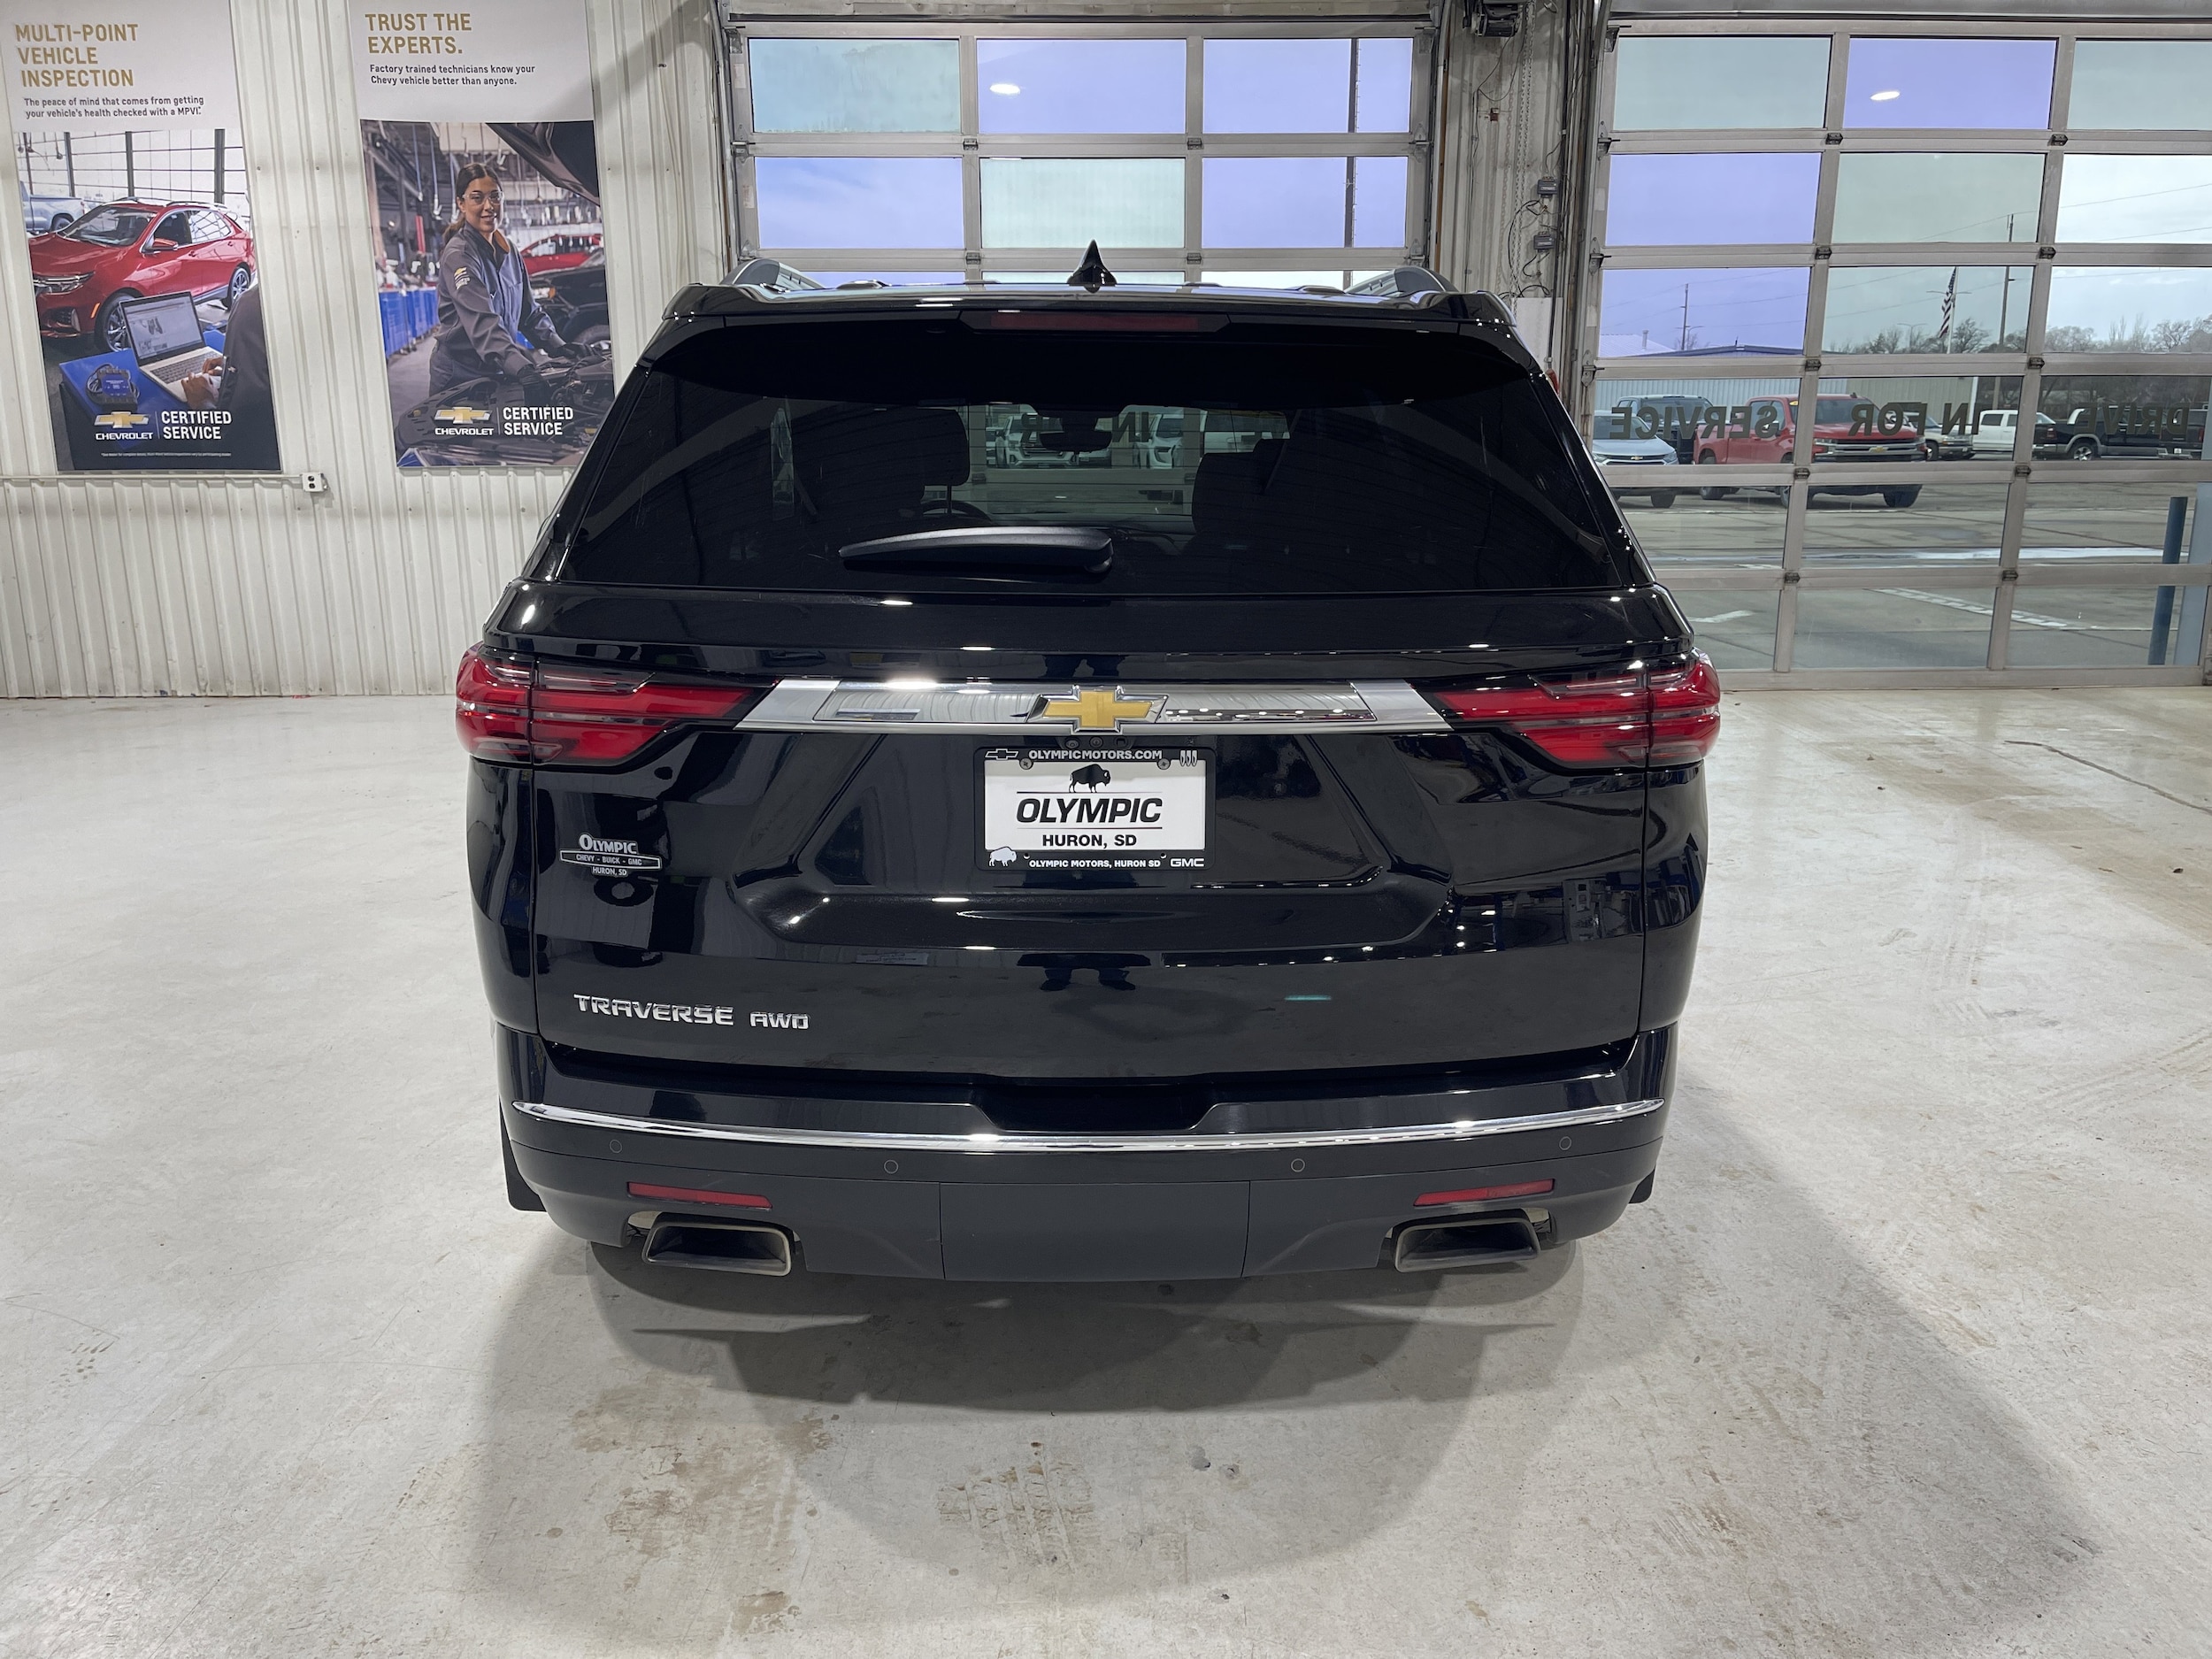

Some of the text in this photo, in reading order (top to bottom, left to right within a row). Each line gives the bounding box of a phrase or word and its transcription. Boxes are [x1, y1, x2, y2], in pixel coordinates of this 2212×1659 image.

[365, 13, 472, 32] TRUST THE
[15, 23, 138, 42] MULTI-POINT
[368, 36, 463, 54] EXPERTS.
[18, 47, 98, 65] VEHICLE
[370, 64, 535, 75] Factory trained technicians know your
[21, 69, 134, 88] INSPECTION
[371, 75, 517, 87] Chevy vehicle better than anyone.
[24, 97, 40, 106] The
[42, 99, 66, 108] peace
[68, 97, 77, 106] of
[173, 96, 204, 106] getting
[26, 111, 44, 119] your
[47, 109, 82, 118] vehicle's
[84, 108, 111, 117] health
[113, 108, 148, 117] checked
[161, 411, 232, 425] CERTIFIED
[503, 407, 573, 420] CERTIFIED
[163, 426, 222, 440] SERVICE
[503, 422, 563, 435] SERVICE
[95, 432, 154, 441] CHEVROLET
[1028, 749, 1163, 761] OLYMPICMOTORS.COM
[1017, 798, 1163, 823] OLYMPIC
[1042, 834, 1137, 849] HURON, SD
[576, 853, 595, 862] CHEVY
[1029, 859, 1161, 869] OLYMPIC MOTORS, HURON SD
[1170, 858, 1205, 867] GMC
[592, 866, 618, 876] HURON,
[573, 993, 810, 1030] TRAVERSE AWD
